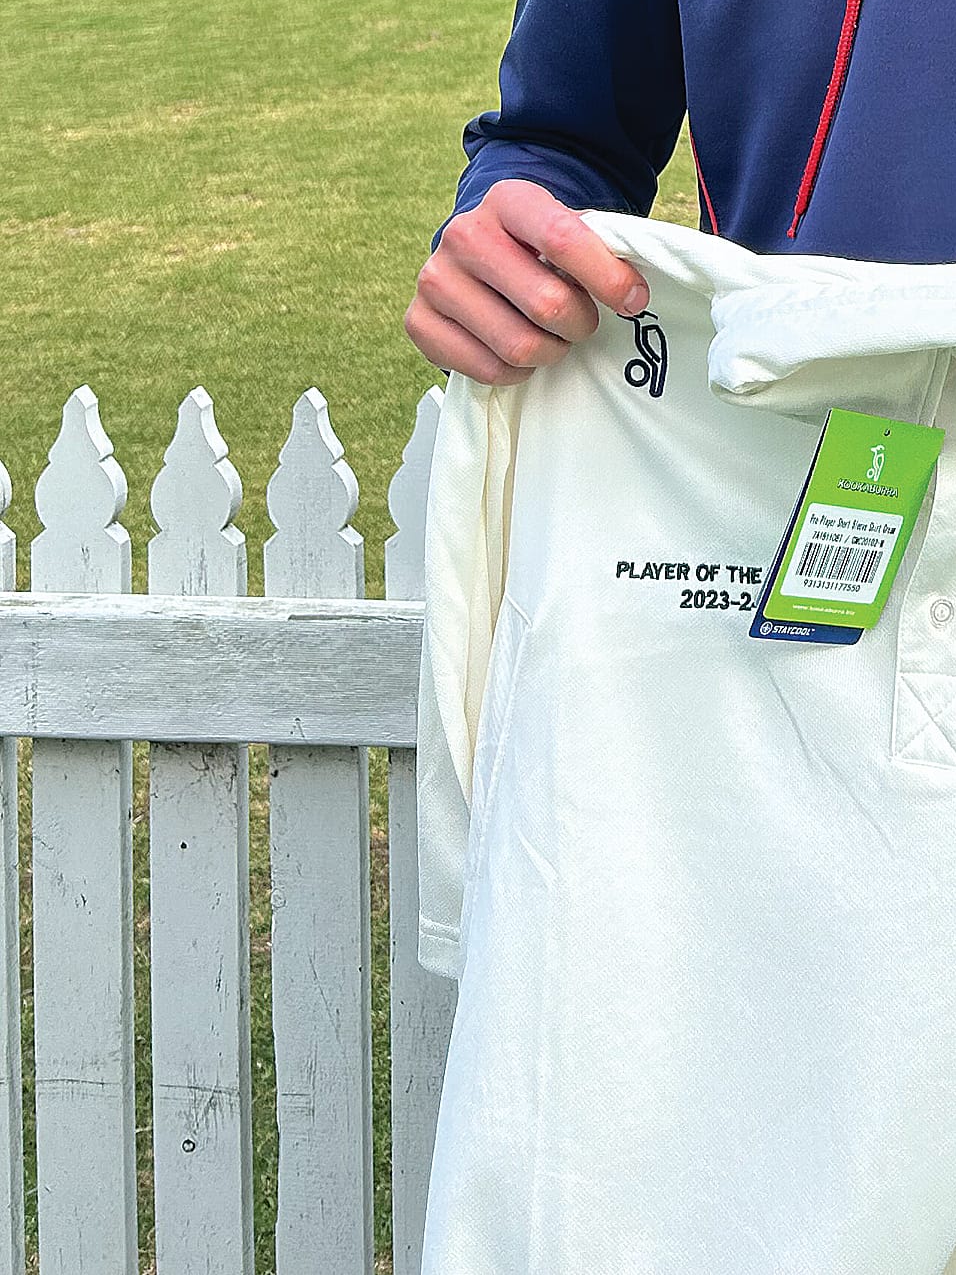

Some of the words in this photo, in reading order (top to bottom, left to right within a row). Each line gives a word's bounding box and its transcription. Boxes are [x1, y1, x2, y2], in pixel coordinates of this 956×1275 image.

[616, 561, 690, 581] PLAYER
[695, 563, 721, 582] OF
[726, 565, 763, 584] THE
[680, 589, 757, 612] 2023-2
